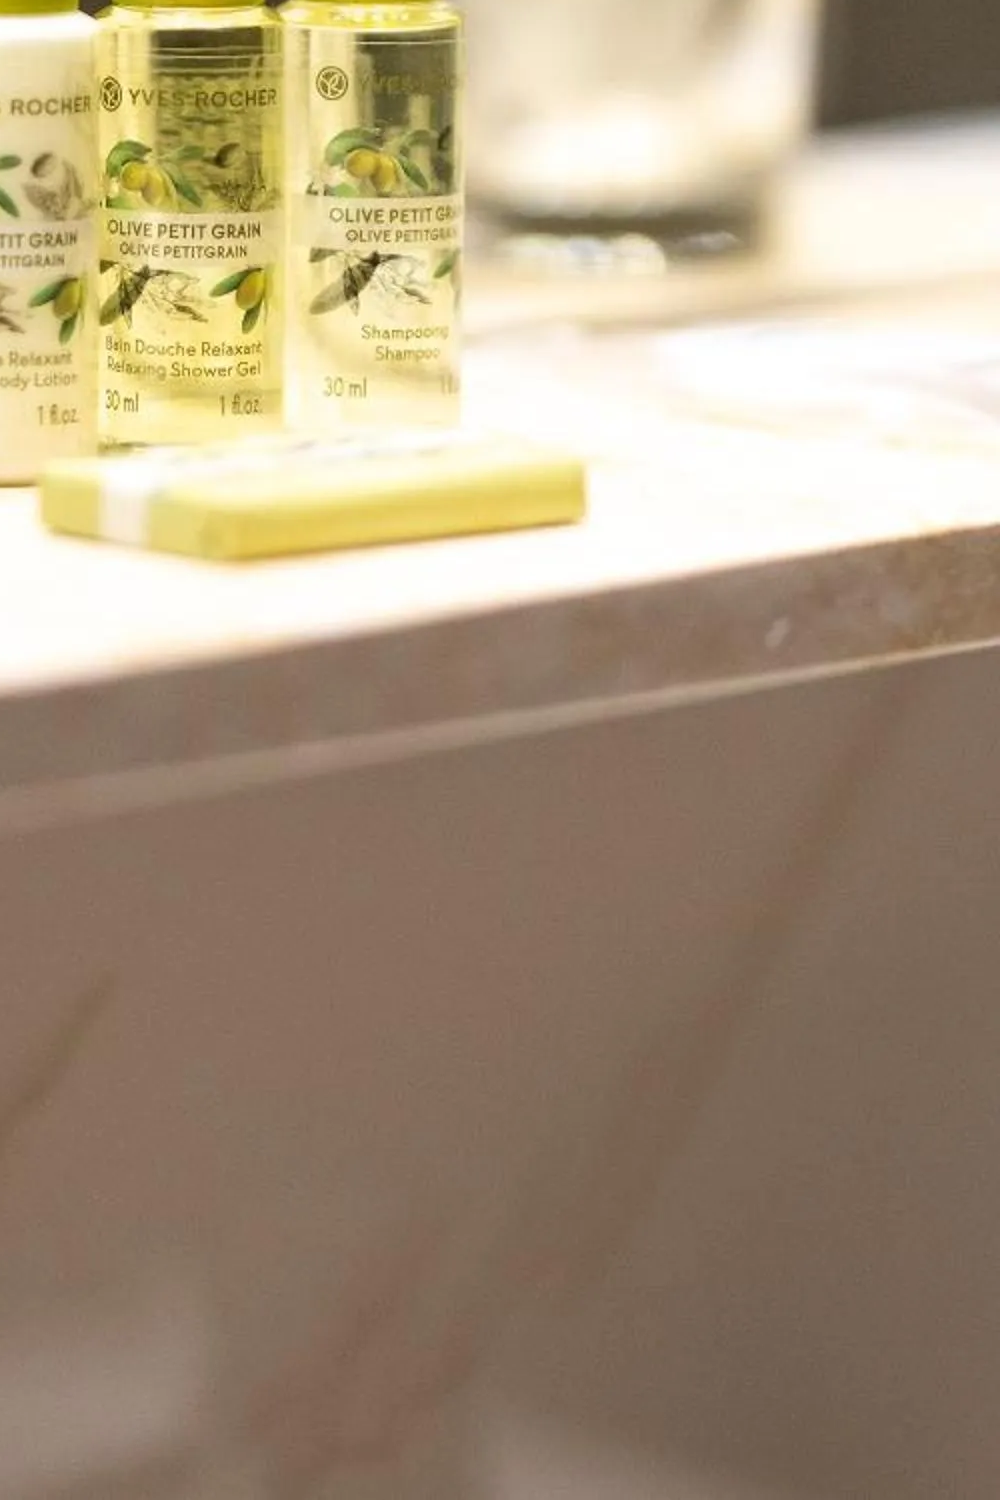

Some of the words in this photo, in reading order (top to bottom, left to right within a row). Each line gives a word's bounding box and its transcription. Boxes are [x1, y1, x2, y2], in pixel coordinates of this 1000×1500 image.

[10, 94, 91, 116] ROCHER
[129, 89, 185, 108] YVES
[194, 88, 277, 108] ROCHER
[329, 207, 385, 224] OLIVE
[390, 207, 432, 224] PETIT
[107, 218, 152, 238] OLIVE
[157, 222, 207, 241] PETIT
[211, 221, 262, 241] GRAIN
[345, 228, 391, 243] OLIVE
[29, 230, 79, 250] GRAIN
[119, 241, 160, 258] OLIVE
[164, 244, 248, 260] PETITGRAIN
[105, 336, 131, 354] Bain
[135, 338, 197, 358] Douche
[201, 340, 263, 358] Relaxant
[375, 346, 441, 363] Shampoo
[9, 349, 73, 368] Relaxant
[107, 356, 167, 381] Relaxing
[170, 361, 233, 378] Shower
[236, 360, 261, 378] Gel
[34, 372, 79, 389] Lotion
[323, 376, 344, 398] 30
[348, 376, 367, 399] ml
[105, 389, 121, 412] 30
[123, 392, 139, 414] ml
[218, 394, 226, 417] 1
